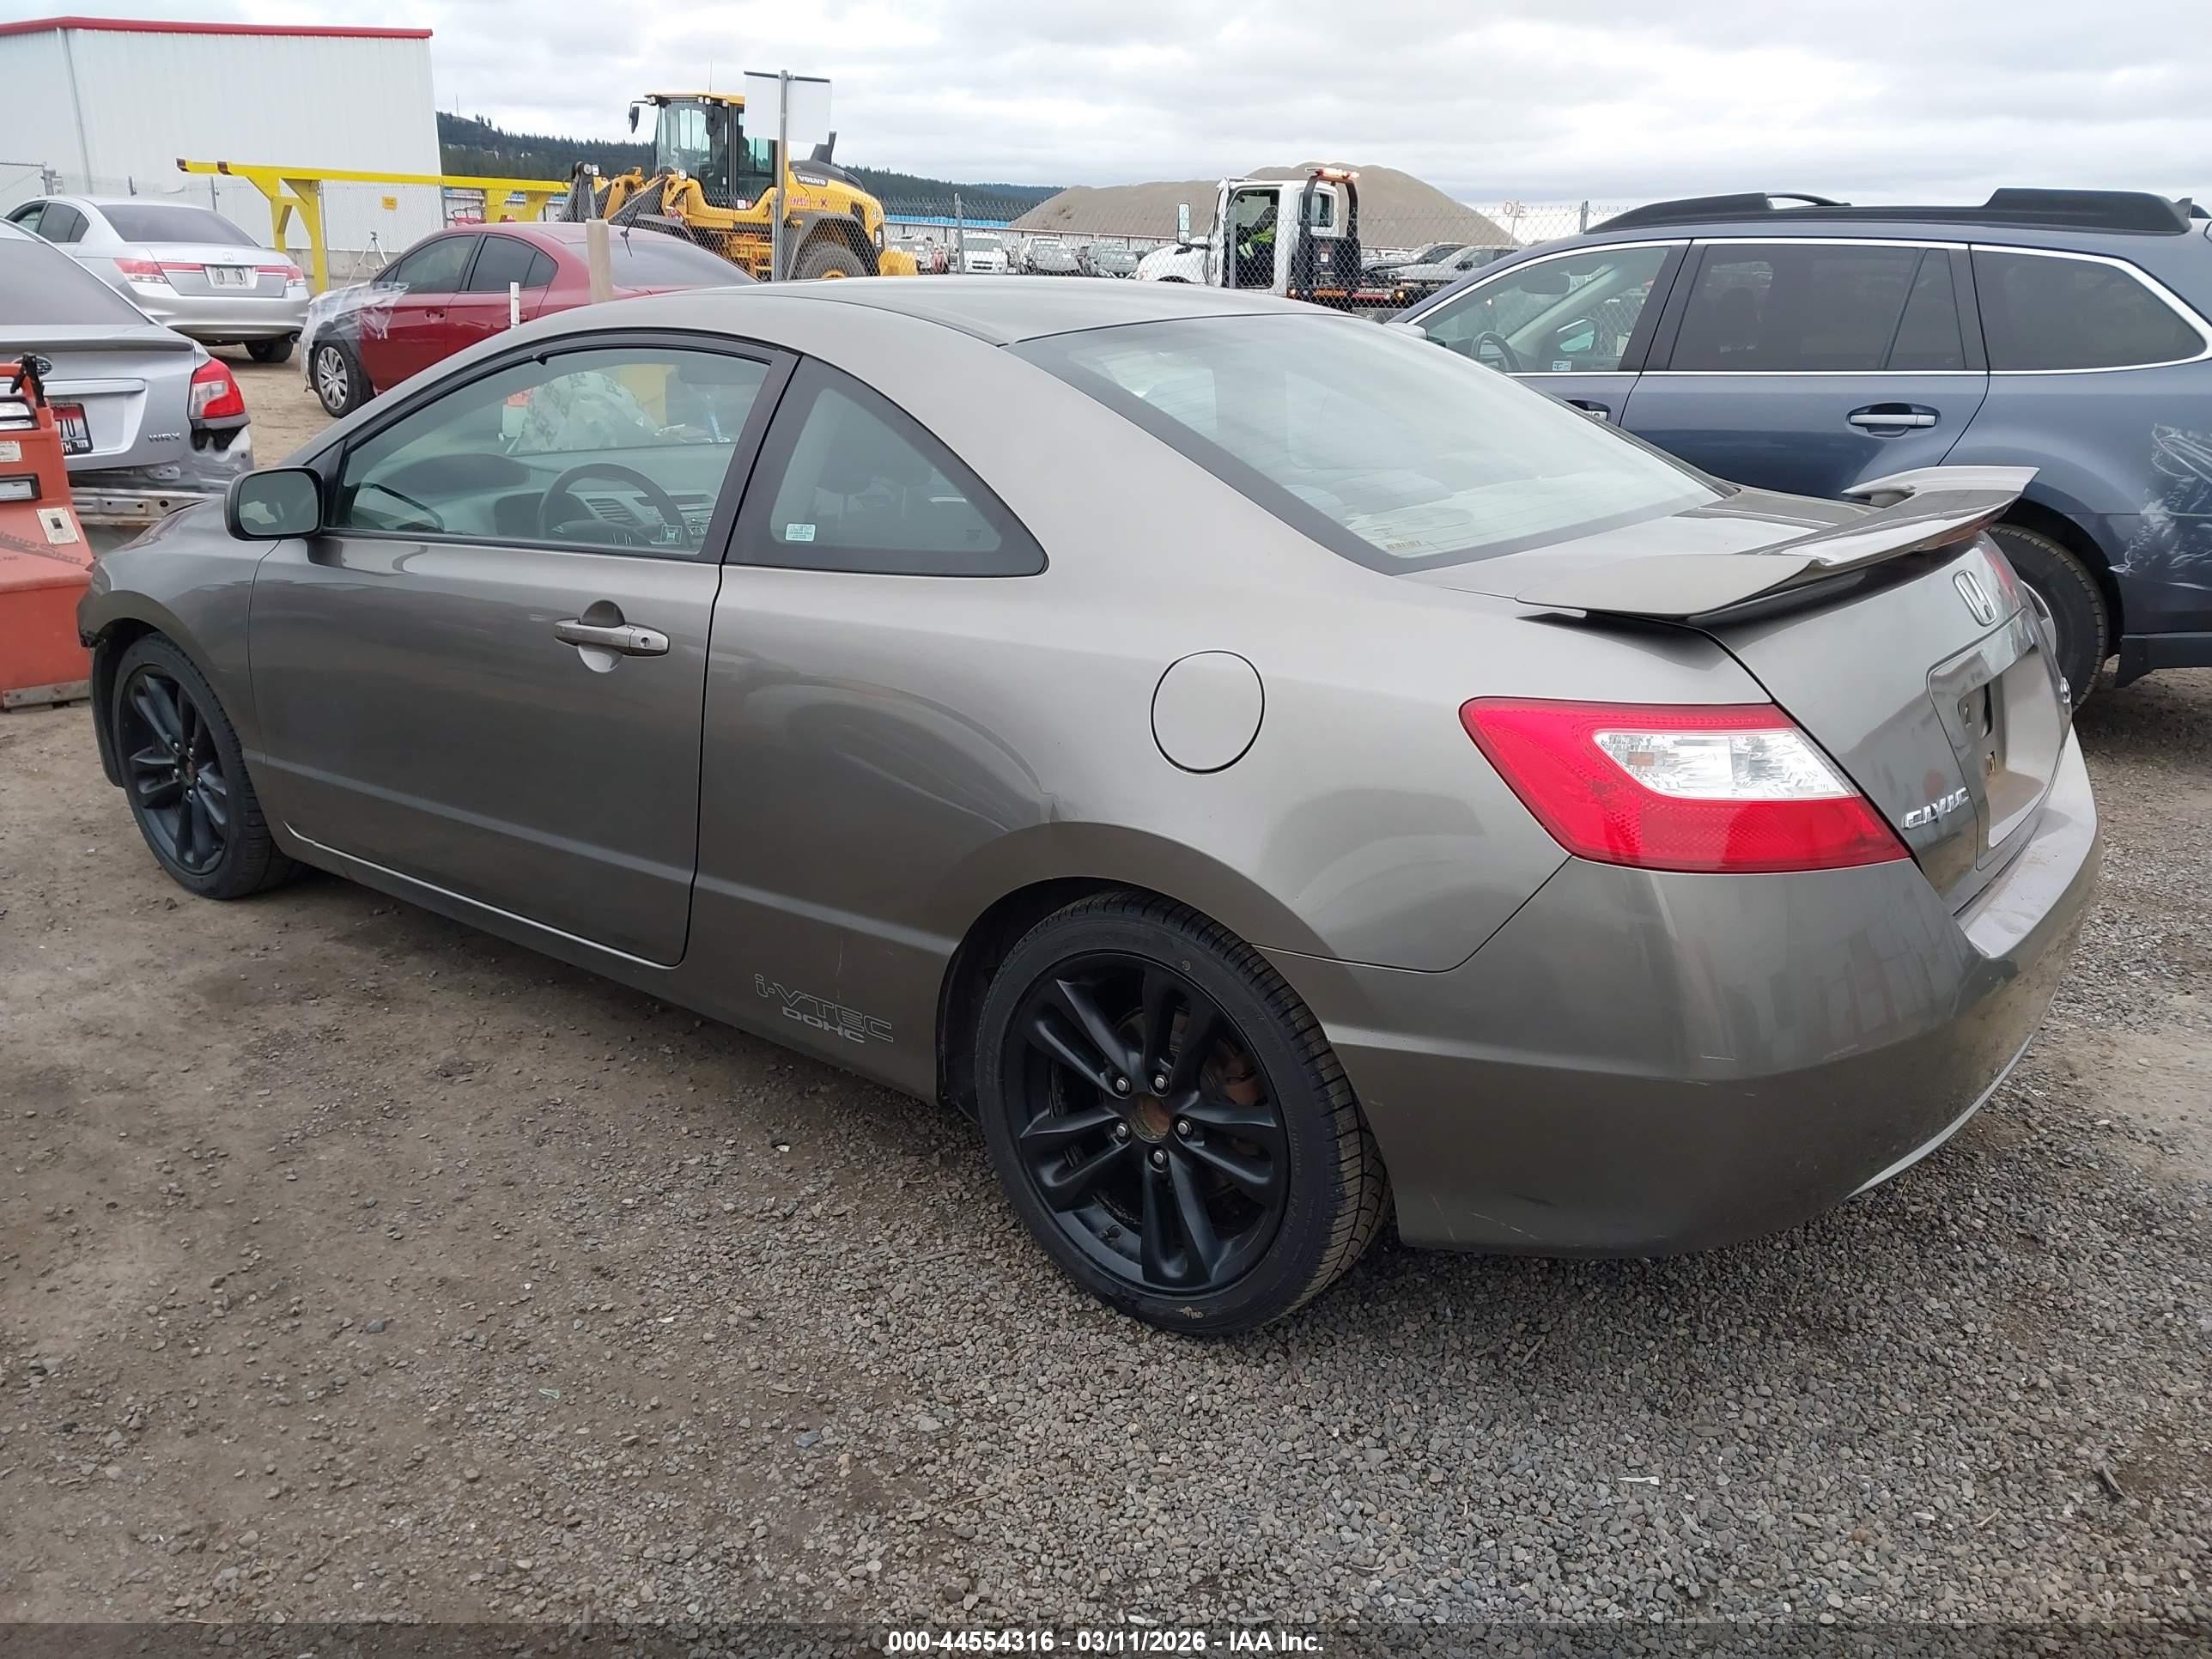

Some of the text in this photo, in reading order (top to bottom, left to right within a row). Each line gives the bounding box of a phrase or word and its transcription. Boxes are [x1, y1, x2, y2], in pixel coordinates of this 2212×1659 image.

[797, 175, 826, 185] VOLVO
[148, 432, 180, 442] WRX
[1901, 787, 1970, 830] CIVIC
[755, 973, 894, 1043] i-VTEC
[781, 1006, 865, 1044] DOHC
